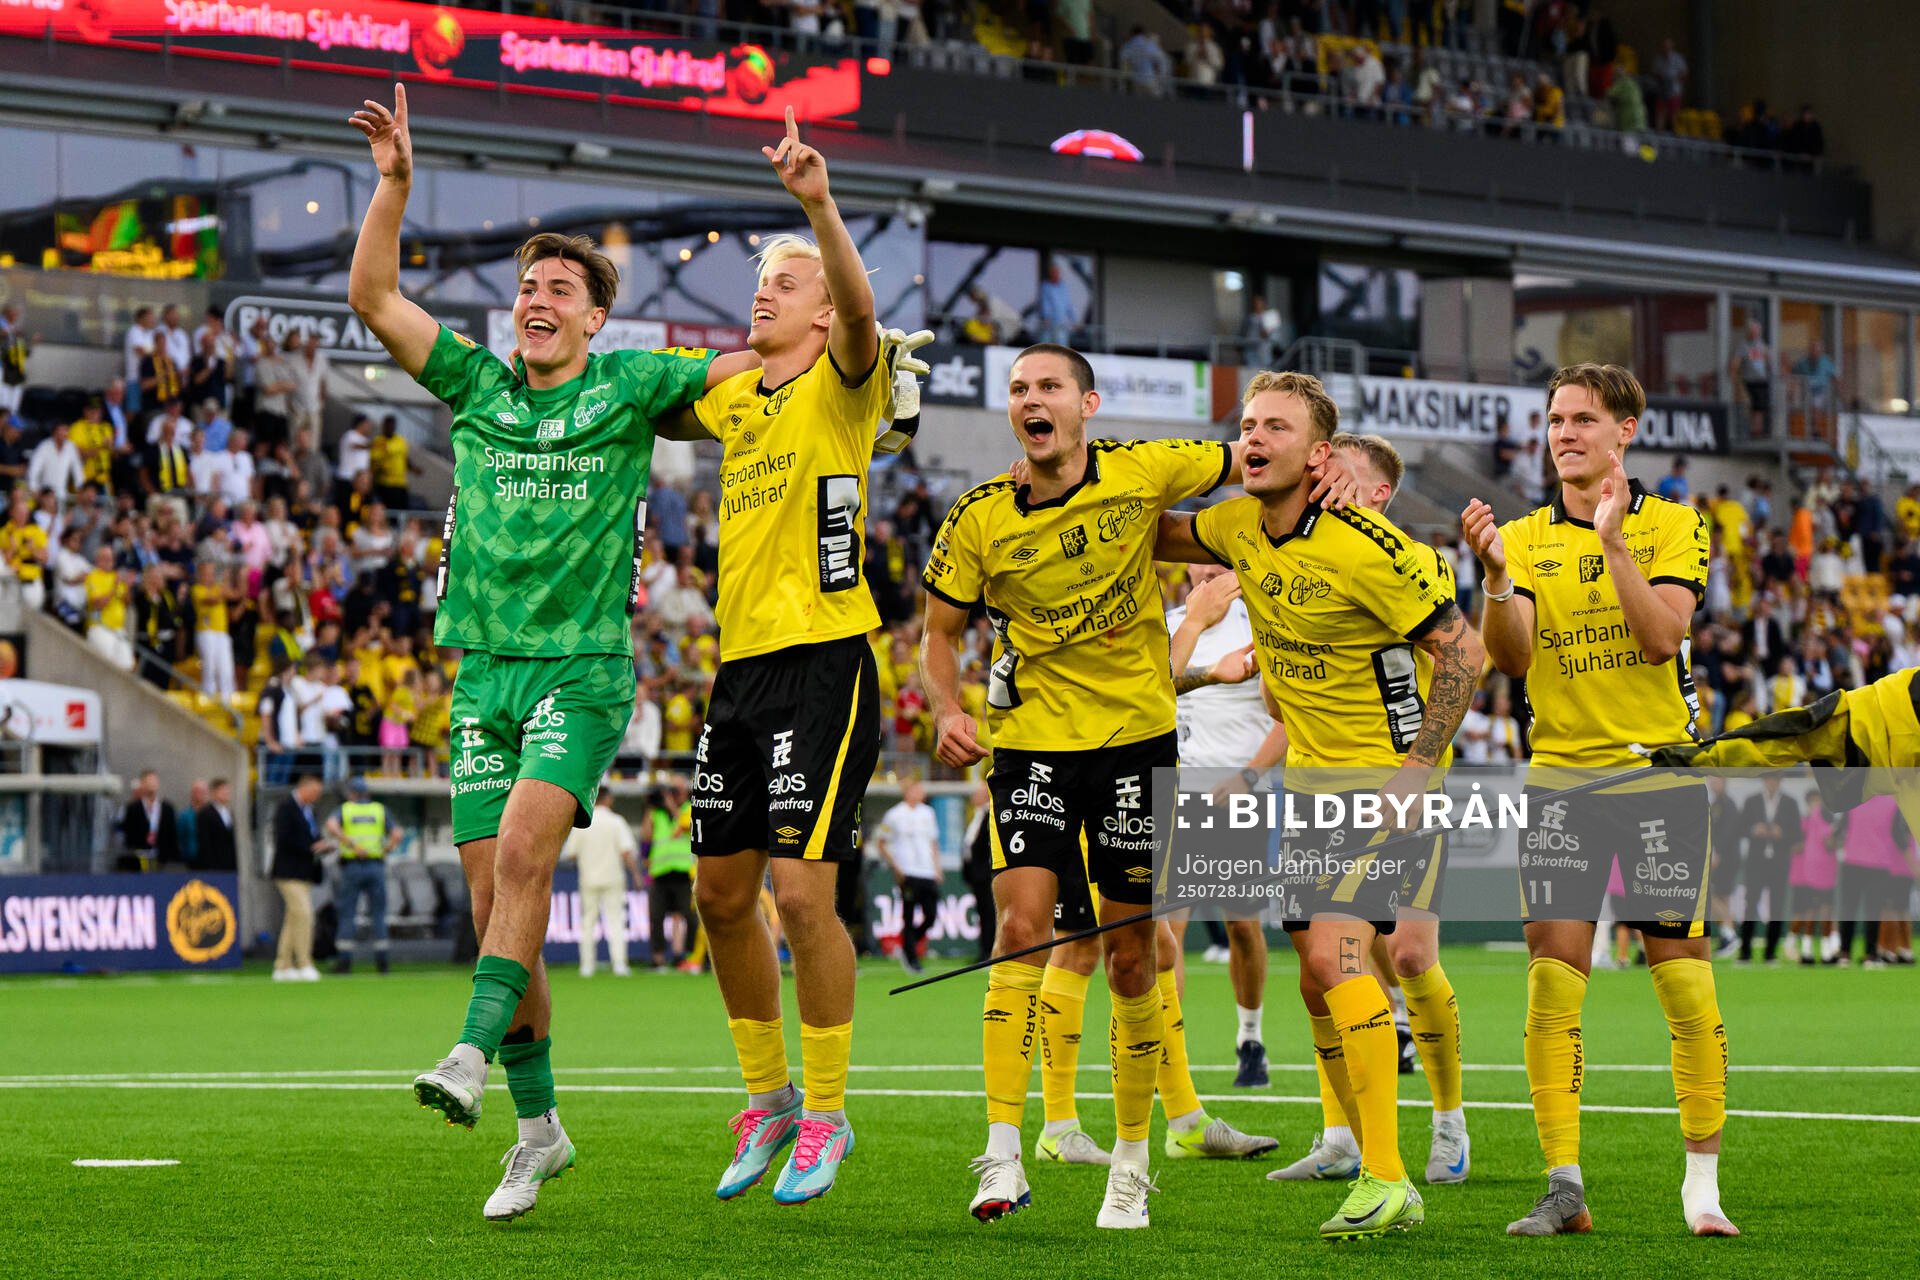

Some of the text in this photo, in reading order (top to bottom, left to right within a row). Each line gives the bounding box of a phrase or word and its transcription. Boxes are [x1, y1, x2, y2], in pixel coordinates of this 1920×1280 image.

[164, 0, 411, 53] Sparbanken Sjuhärad
[500, 31, 629, 77] Sparbanken
[1634, 407, 1717, 450] OLINA
[484, 447, 604, 473] Sparbanken
[720, 451, 797, 488] arbanken
[495, 476, 587, 501] Sjuhärad
[1097, 500, 1145, 543] Elfsborg
[1016, 558, 1039, 568] umbro
[1066, 574, 1104, 592] TOVEKS
[1571, 606, 1608, 617] TOVEKS
[1255, 628, 1334, 656] arbanken
[454, 750, 505, 778] ellos
[458, 777, 512, 795] Skrotfrag
[692, 763, 724, 792] llos
[1011, 783, 1066, 814] ellos
[1014, 809, 1066, 831] Skrotfrag
[1102, 810, 1156, 835] ellos
[777, 836, 799, 845] umbro
[1009, 830, 1026, 854] 6
[1110, 836, 1162, 851] Skrotfrag
[1526, 827, 1580, 851] ellos
[1531, 854, 1589, 872] Skrotfrag
[1635, 856, 1690, 881] ellos
[1529, 880, 1552, 905] 11
[1644, 884, 1697, 900] Skrotfrag
[1659, 920, 1682, 928] umbro
[1020, 994, 1037, 1062] PAROY
[1350, 1019, 1391, 1032] umbro
